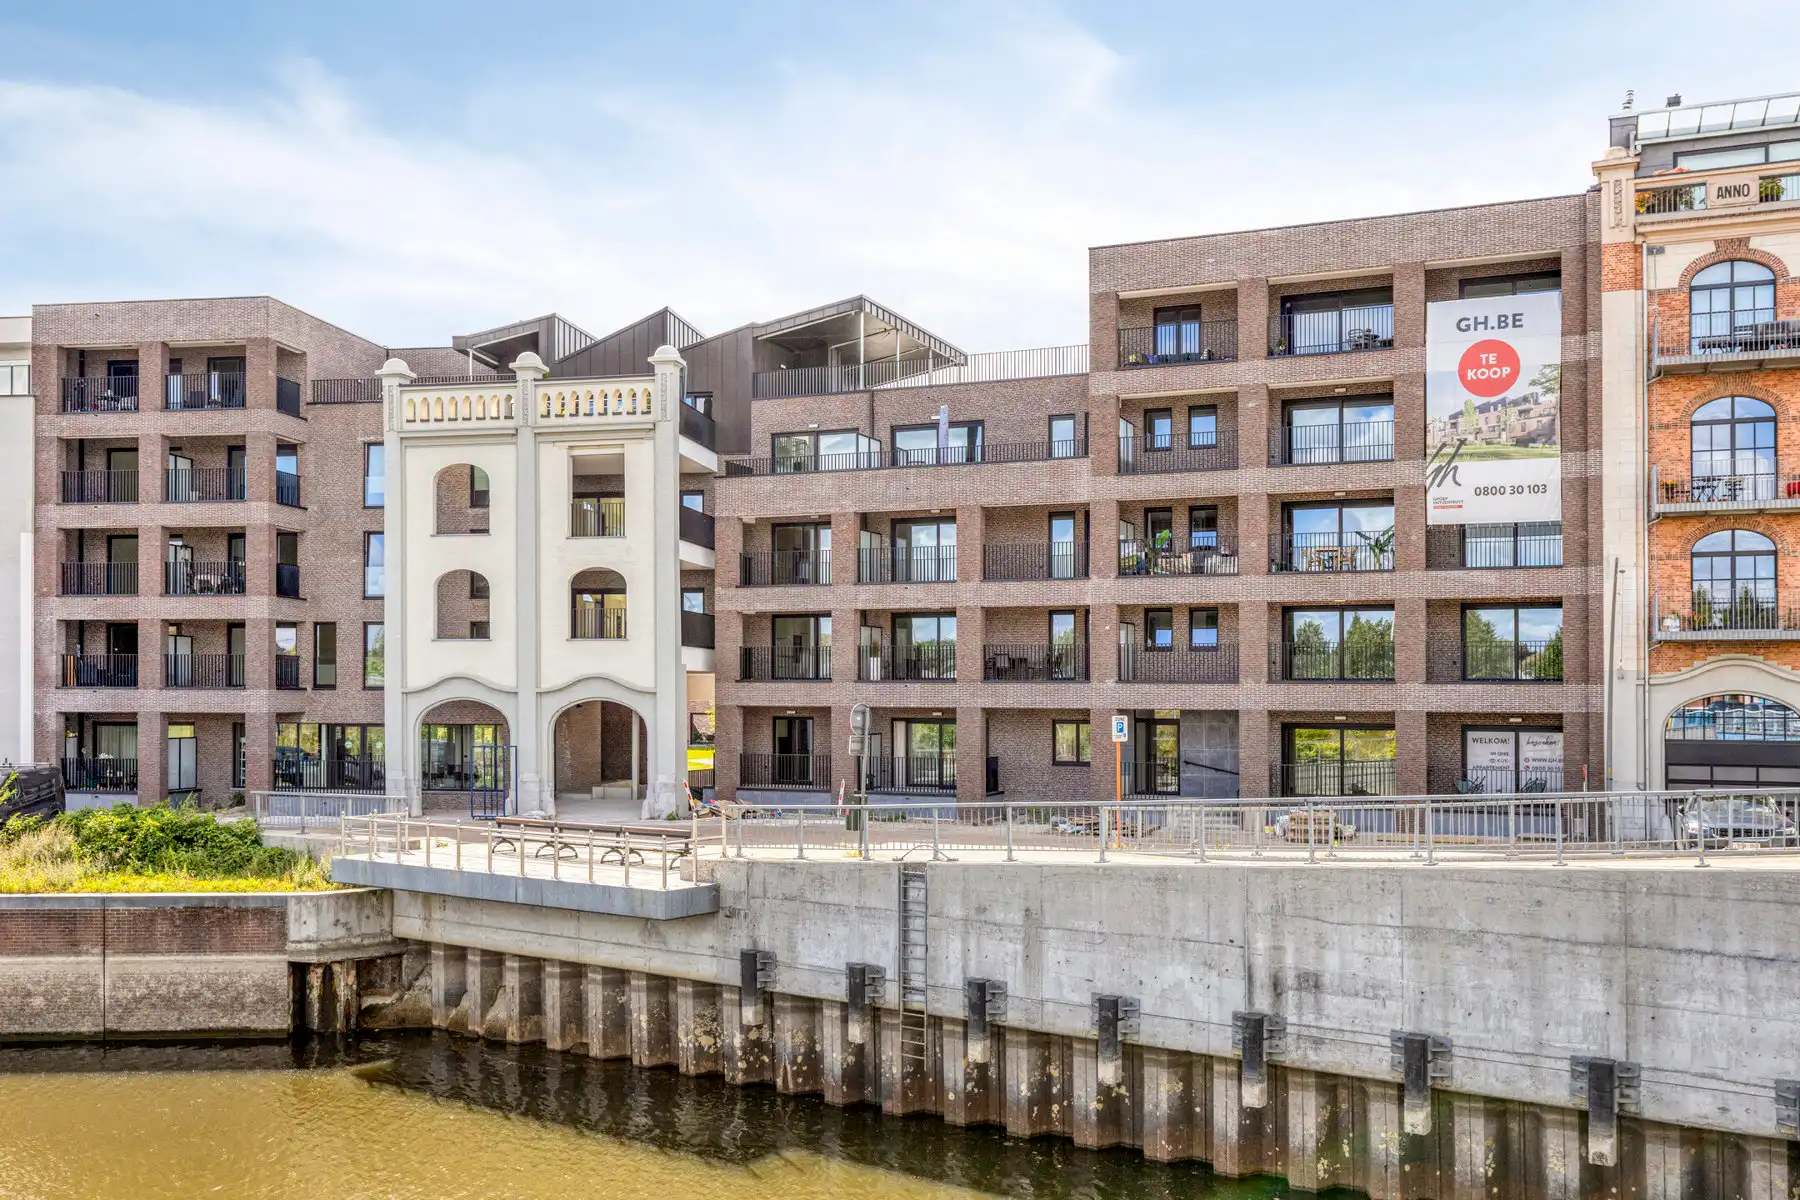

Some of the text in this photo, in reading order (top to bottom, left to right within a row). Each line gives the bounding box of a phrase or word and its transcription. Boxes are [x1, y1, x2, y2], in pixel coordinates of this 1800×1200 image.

[1717, 184, 1750, 199] ANNO
[1456, 312, 1524, 332] GH.BE
[1479, 353, 1497, 366] TE
[1467, 366, 1511, 380] KOOP
[1474, 483, 1548, 497] 0800 30 103
[1471, 737, 1511, 745] WELKOM!
